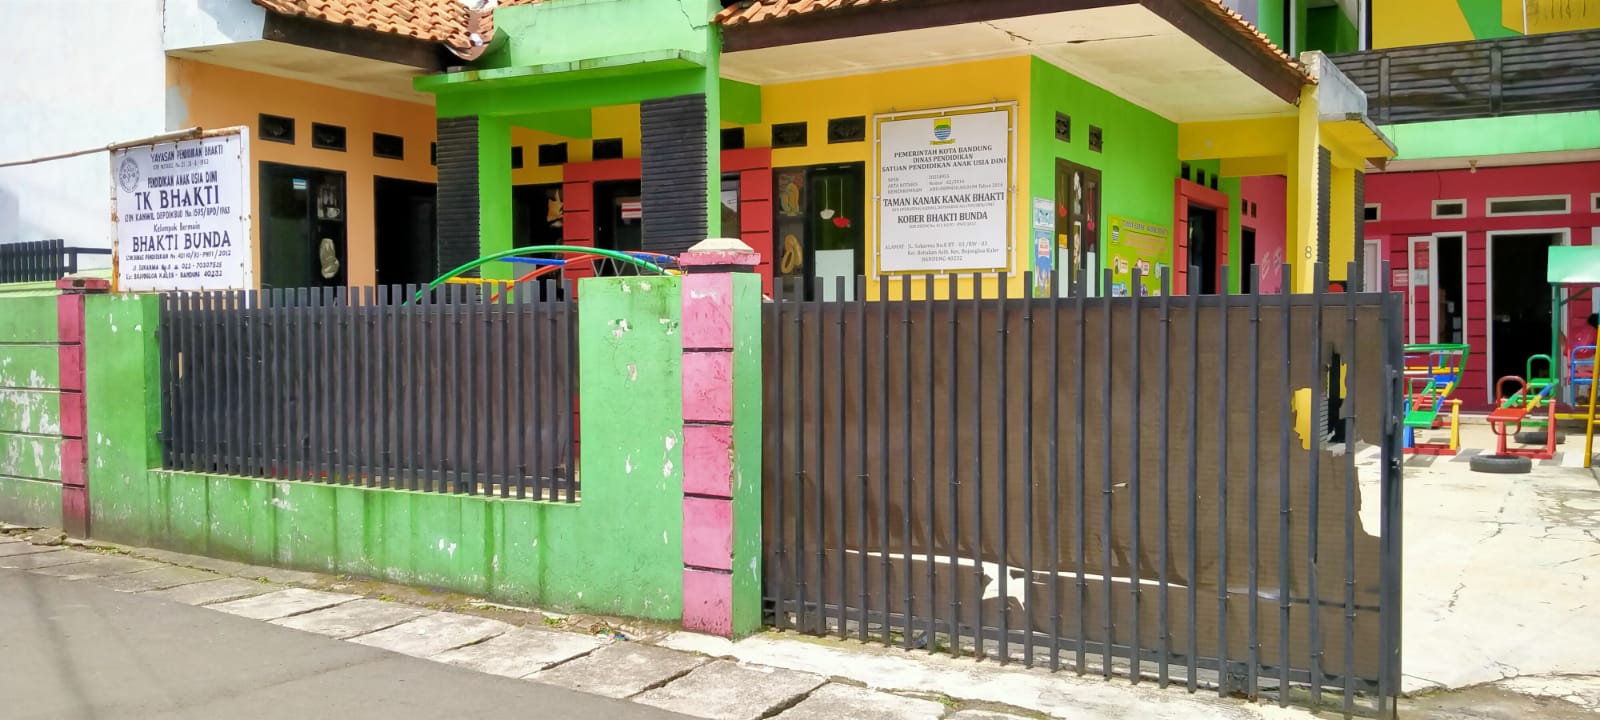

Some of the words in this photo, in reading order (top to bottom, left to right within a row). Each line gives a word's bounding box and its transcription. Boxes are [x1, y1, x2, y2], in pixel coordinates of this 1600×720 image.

[151, 150, 174, 162] YAYASAN
[204, 144, 223, 157] BHAKTI
[894, 148, 938, 158] PEMERINTAH
[939, 147, 957, 156] KOTA
[958, 145, 993, 155] BANDUNG
[913, 156, 932, 164] DINAS
[933, 153, 973, 163] PENDIDIKAN
[909, 162, 951, 171] PENDIDIKAN
[952, 160, 972, 168] ANAK
[991, 157, 1006, 165] DINI
[148, 174, 174, 188] PENDIDIKAN
[176, 173, 190, 186] ANAK
[191, 172, 204, 184] USIA
[205, 170, 218, 183] DINI
[135, 191, 152, 210] TK
[160, 185, 219, 209] BHAKTI
[883, 198, 911, 207] TAMAN
[912, 195, 941, 206] KANAK
[942, 194, 971, 204] KANAK
[972, 191, 1004, 202] BHAKTI
[897, 214, 925, 224] KOBER
[926, 212, 958, 223] BHAKTI
[959, 211, 989, 221] BUNDA
[153, 223, 178, 233] Kelompok
[179, 221, 200, 231] Bermain
[132, 233, 179, 252] BHAKTI
[184, 230, 232, 249] BUNDA
[1305, 246, 1312, 259] 8
